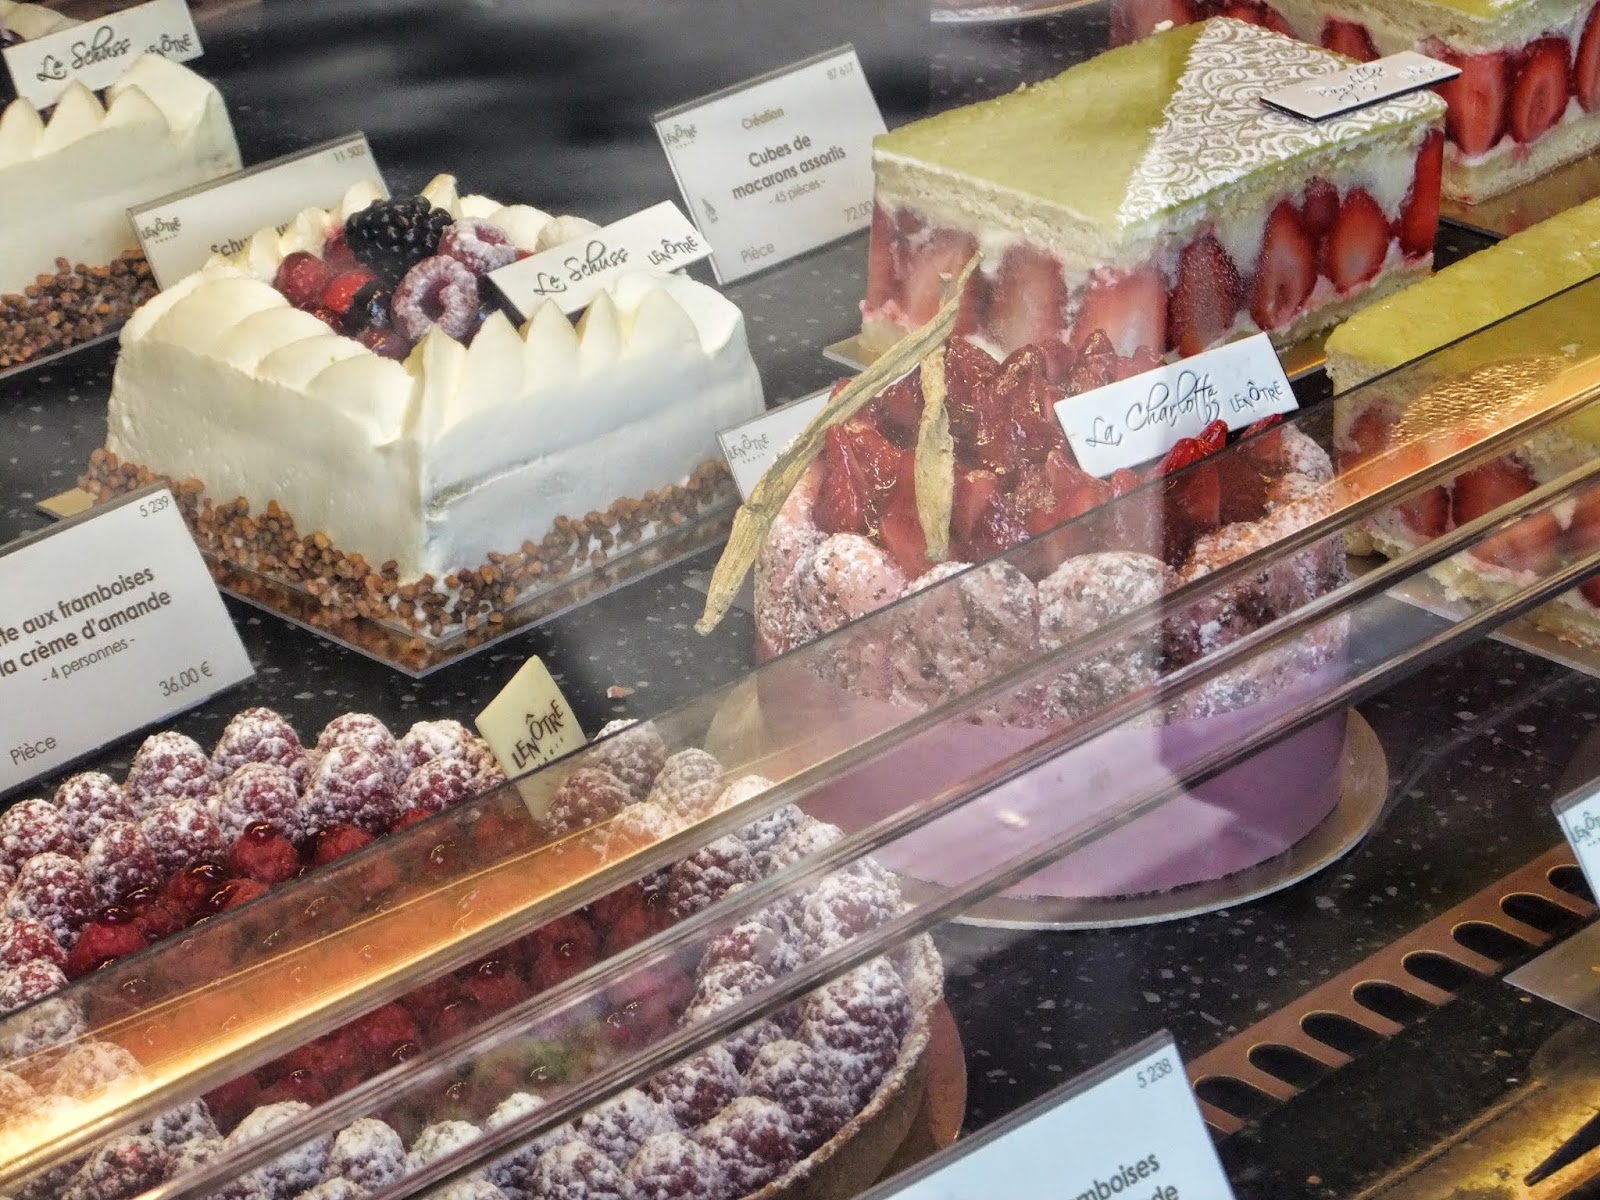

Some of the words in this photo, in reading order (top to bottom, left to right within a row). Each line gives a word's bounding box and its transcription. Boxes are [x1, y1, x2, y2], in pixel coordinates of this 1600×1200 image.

[36, 54, 67, 82] Le
[71, 25, 131, 70] Schuss
[741, 106, 785, 130] Création
[748, 142, 792, 168] Cubes
[793, 135, 811, 152] de
[732, 165, 798, 199] macarons
[799, 145, 847, 174] assortis
[788, 179, 821, 201] pièces
[141, 216, 182, 240] LENÔTRE
[533, 271, 567, 296] Le
[564, 240, 629, 282] Schuss
[647, 235, 699, 266] LENÔTRE
[740, 243, 775, 264] Pièce
[1085, 417, 1123, 448] La
[1125, 370, 1220, 427] Charlotte
[1229, 381, 1284, 413] LENÔTRE
[728, 432, 770, 460] LENÔTRE
[139, 504, 149, 518] 5
[149, 495, 170, 515] 239
[22, 610, 59, 634] aux
[58, 566, 155, 619] framboises
[20, 632, 79, 667] crème
[81, 591, 172, 640] d'amande
[51, 667, 60, 680] 4
[61, 637, 129, 679] personnes
[159, 667, 200, 697] 36,00
[200, 661, 213, 678] €
[9, 736, 57, 766] Pièce
[511, 700, 565, 769] LENÔTRE
[1137, 1071, 1147, 1088] 5
[1147, 1058, 1172, 1083] 238
